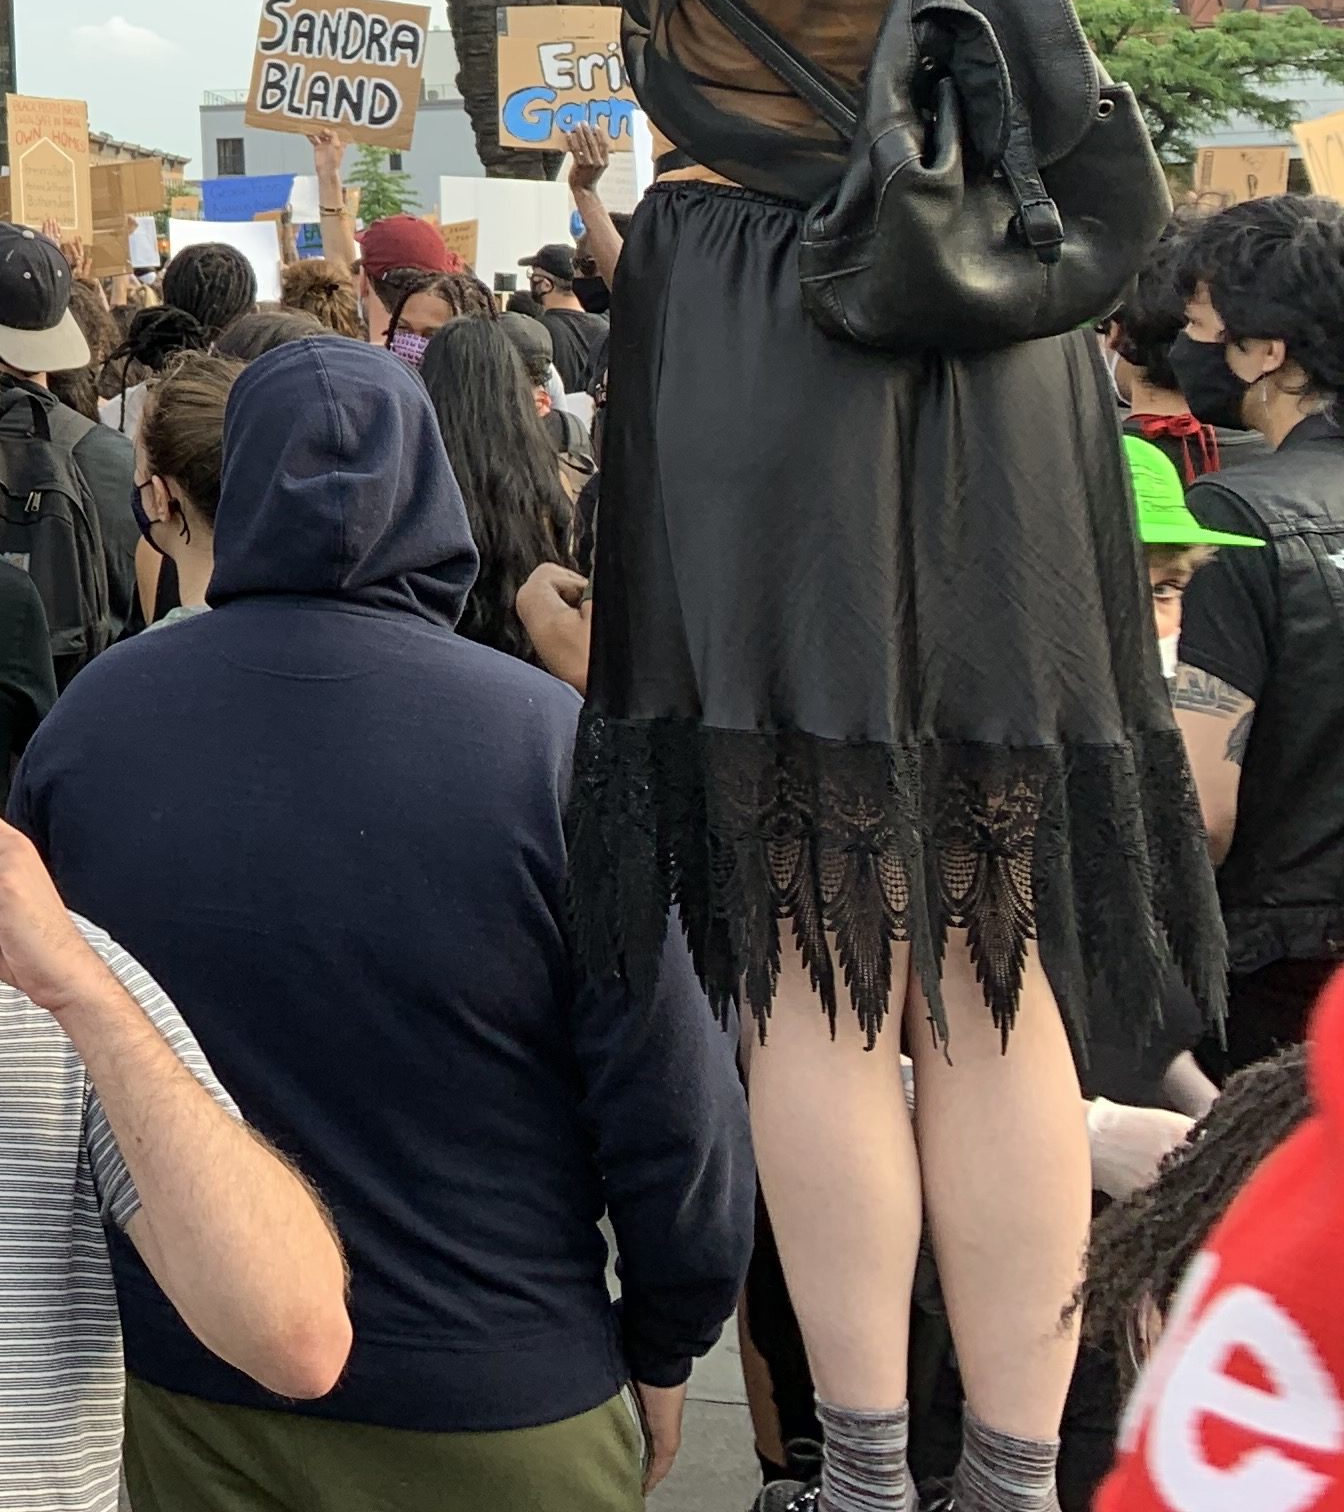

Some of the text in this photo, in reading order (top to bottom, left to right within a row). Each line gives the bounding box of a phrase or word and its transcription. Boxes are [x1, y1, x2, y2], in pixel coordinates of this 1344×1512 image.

[537, 40, 630, 92] Eri
[259, 59, 404, 128] BLAND
[15, 128, 42, 146] OWN
